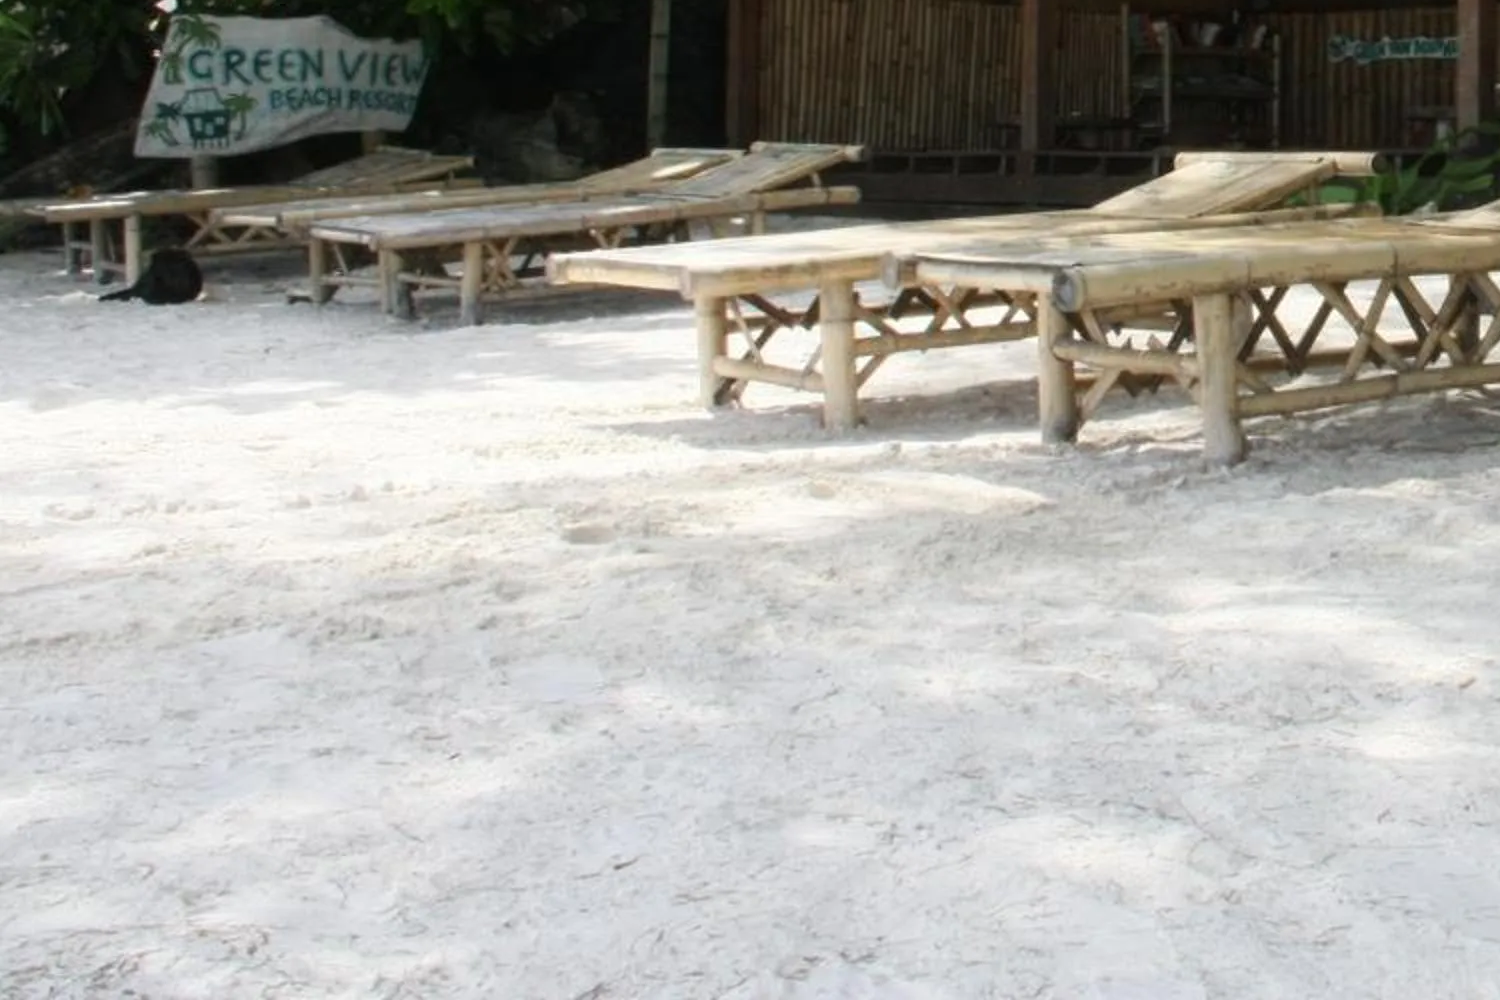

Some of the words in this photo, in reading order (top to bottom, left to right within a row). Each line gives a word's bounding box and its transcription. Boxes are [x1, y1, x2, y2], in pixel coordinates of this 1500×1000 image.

[188, 47, 323, 86] GREEN
[338, 48, 428, 86] VIEW
[269, 87, 341, 112] BEACH
